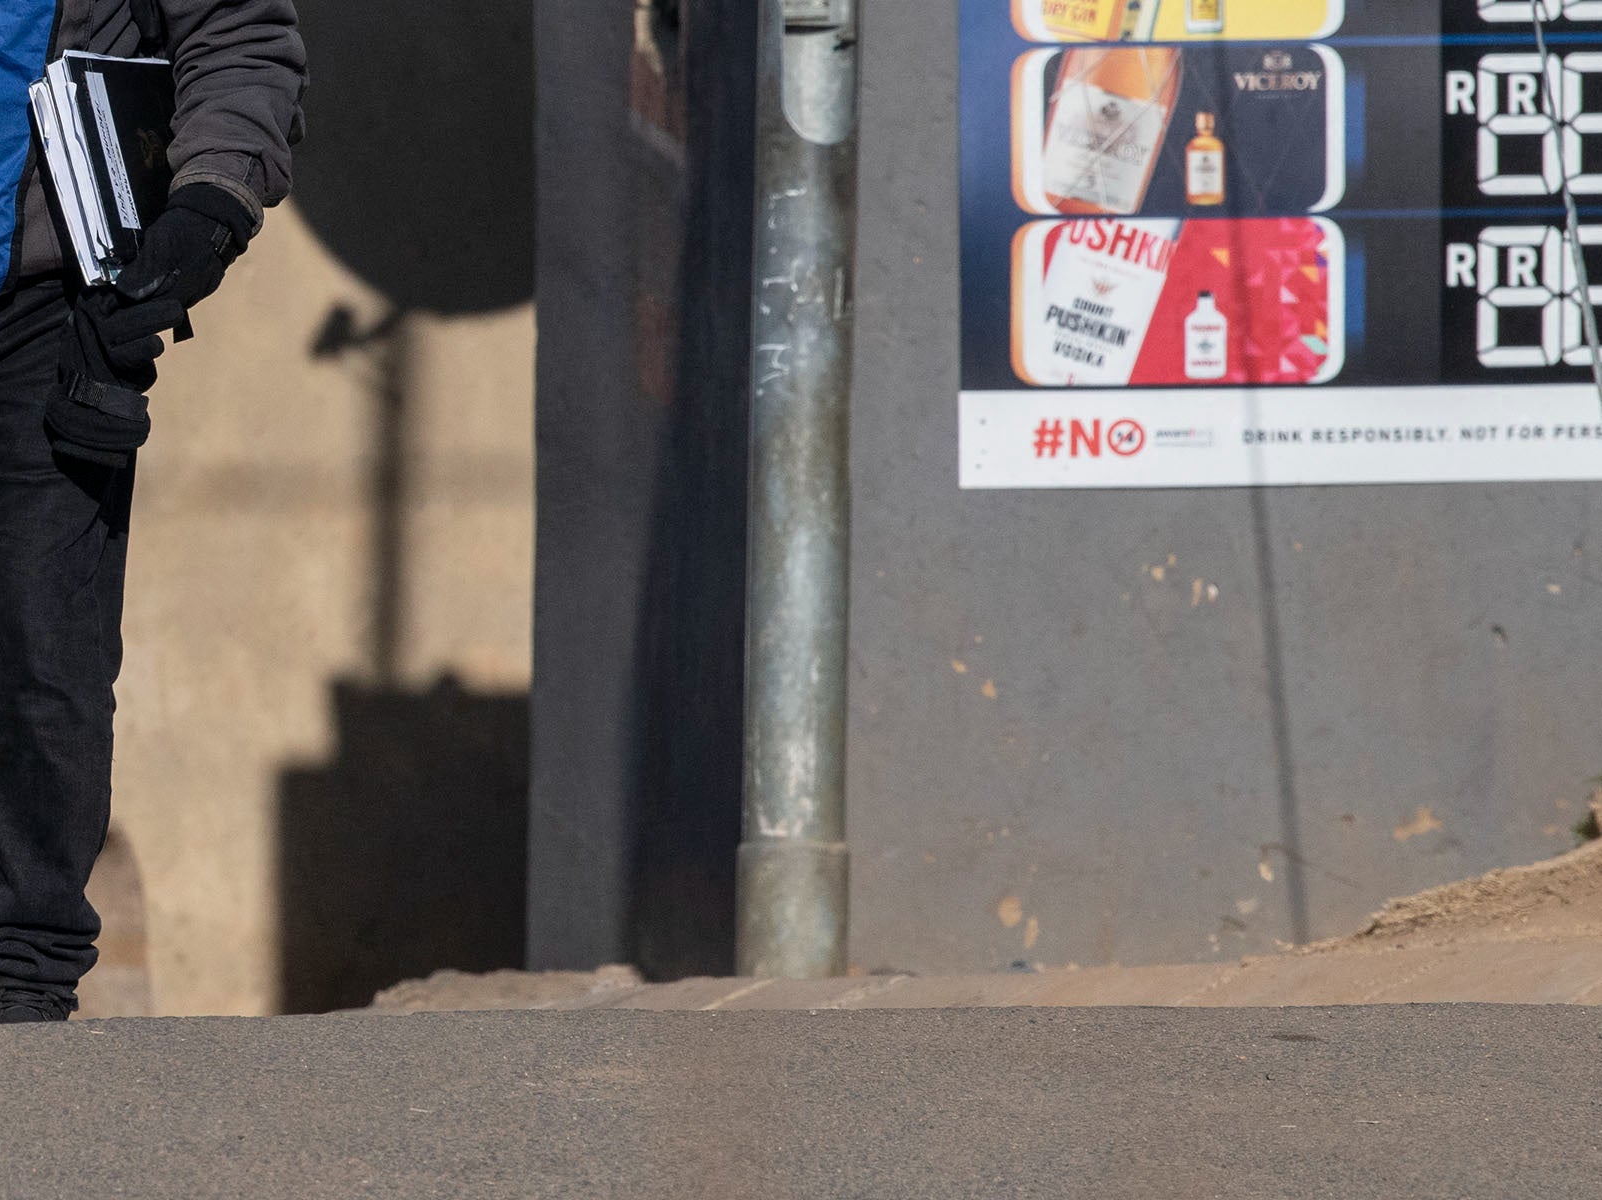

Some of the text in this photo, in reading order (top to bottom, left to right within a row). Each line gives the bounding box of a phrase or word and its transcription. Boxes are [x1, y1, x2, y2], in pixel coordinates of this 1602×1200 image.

[1234, 70, 1321, 92] VICEROY
[1242, 429, 1302, 444] DRINK
[1459, 425, 1499, 441] NOT
[1507, 425, 1544, 440] FOR
